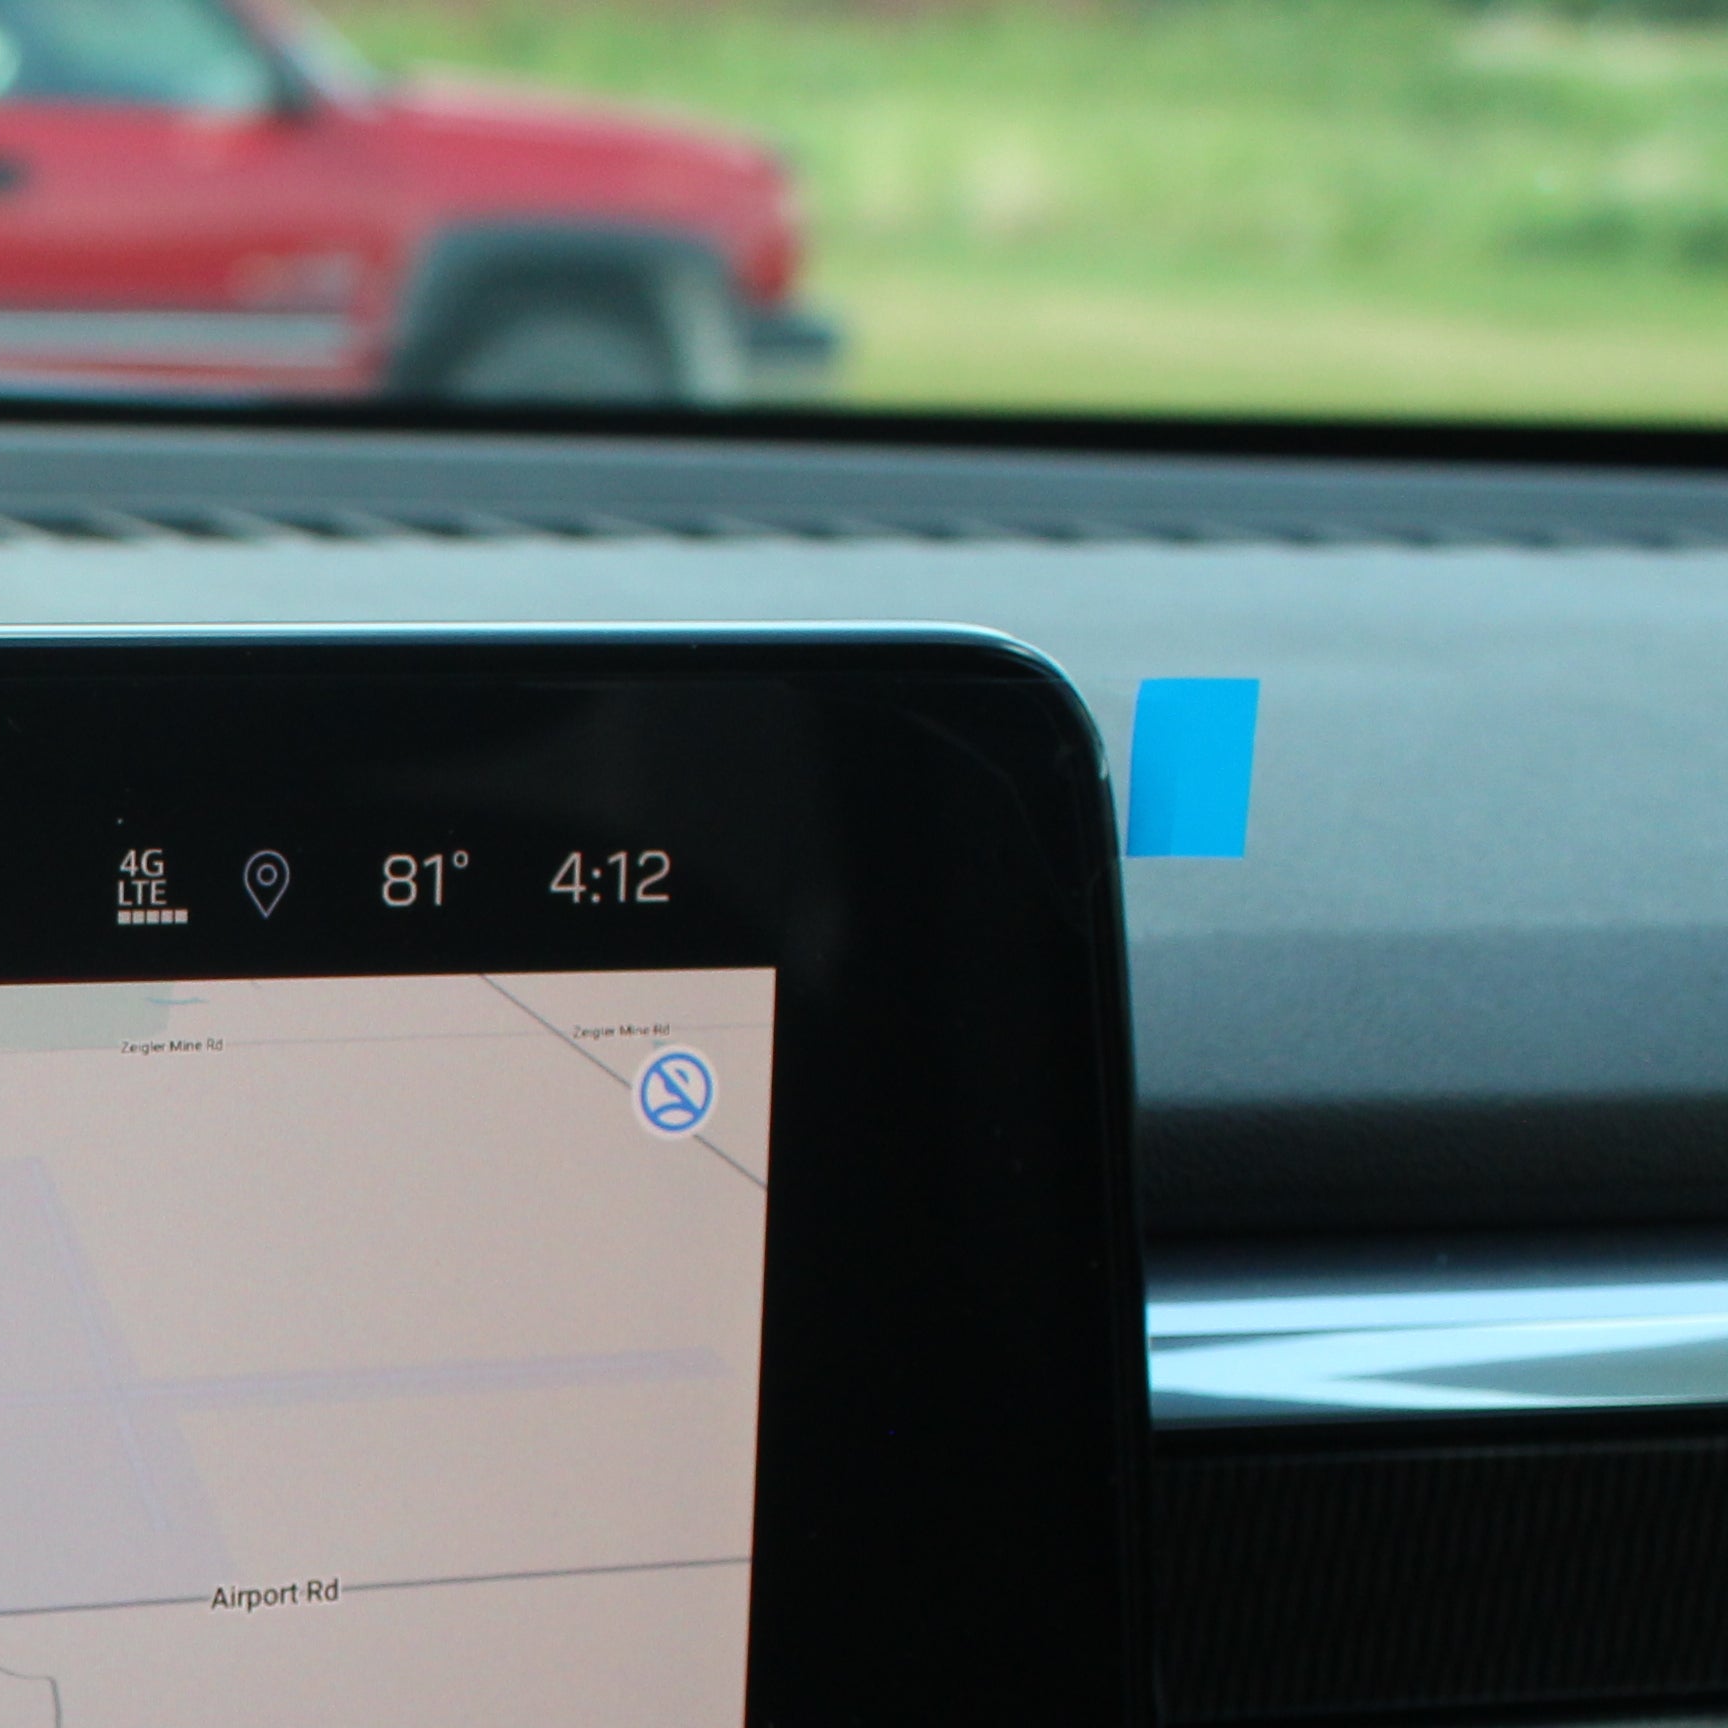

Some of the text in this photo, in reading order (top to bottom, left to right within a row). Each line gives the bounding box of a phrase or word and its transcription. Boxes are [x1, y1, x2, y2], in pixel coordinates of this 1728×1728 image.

[119, 850, 166, 877] 4G
[548, 850, 672, 906] 4:12
[117, 880, 168, 907] LTE
[120, 1037, 224, 1055] Zeigler Mine Rd
[210, 1577, 340, 1613] Airport Rd
